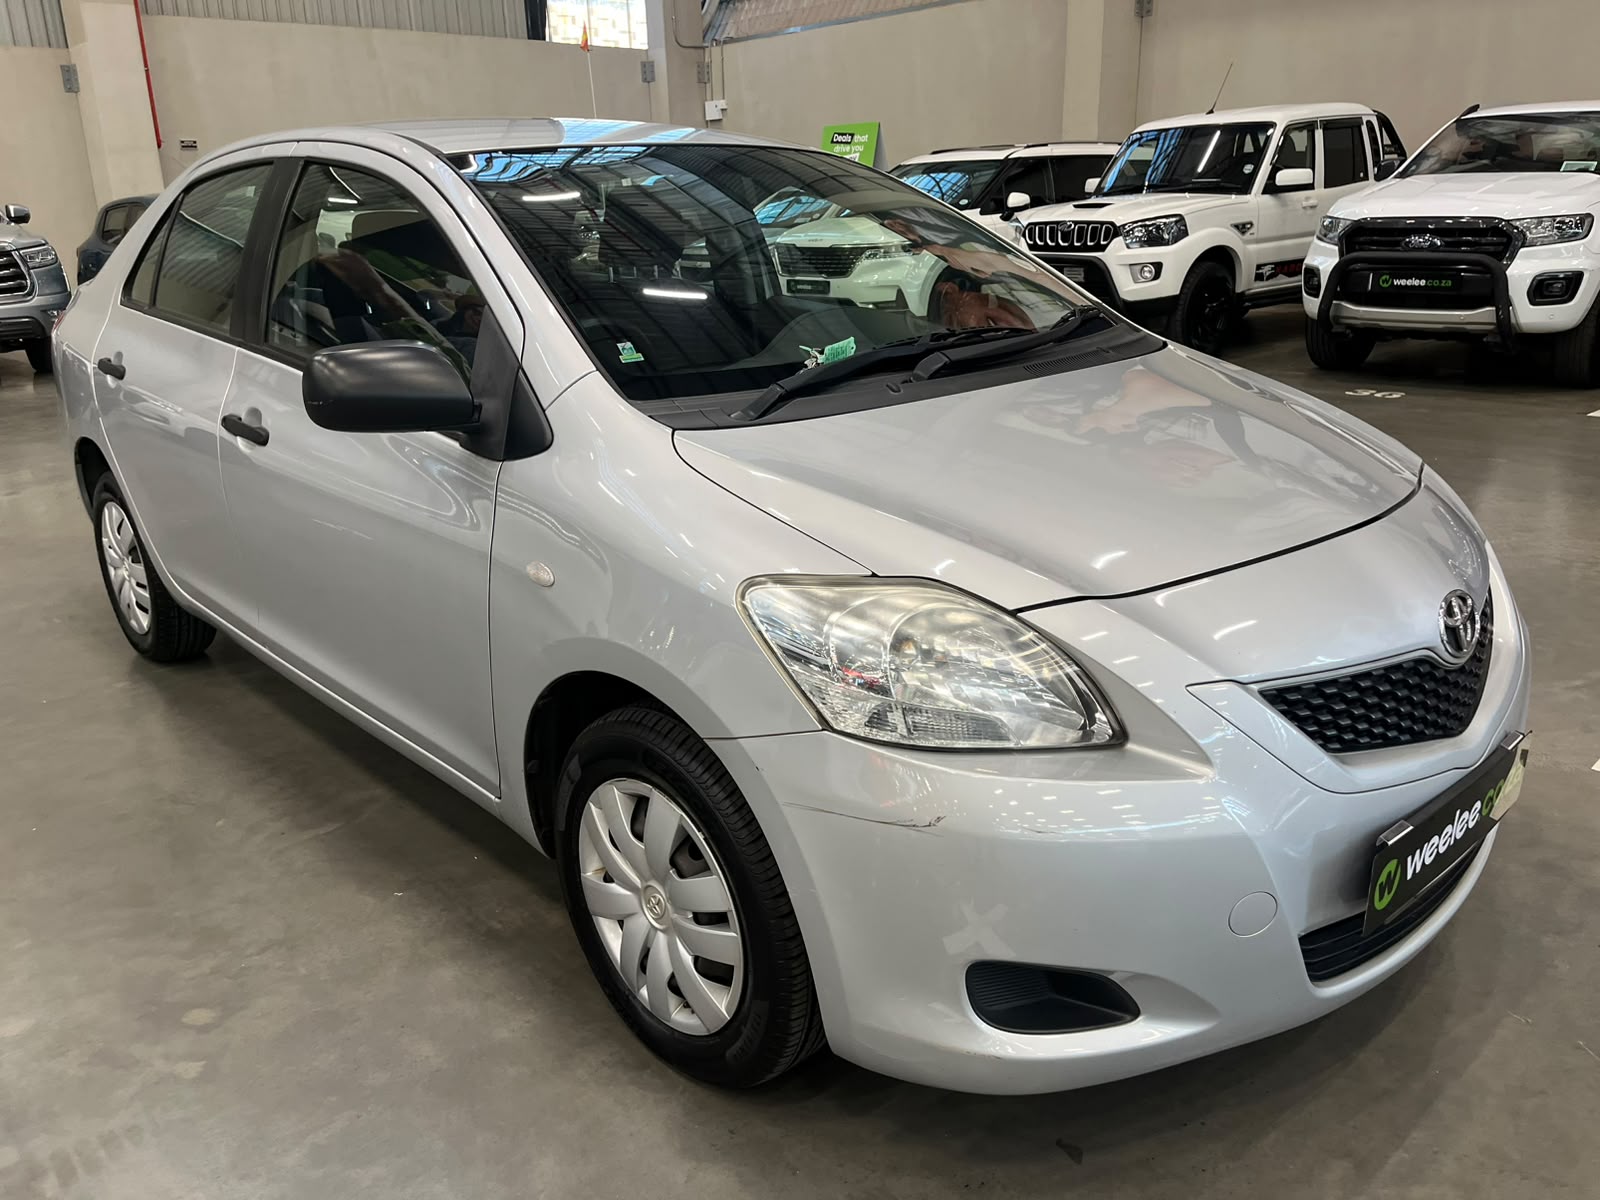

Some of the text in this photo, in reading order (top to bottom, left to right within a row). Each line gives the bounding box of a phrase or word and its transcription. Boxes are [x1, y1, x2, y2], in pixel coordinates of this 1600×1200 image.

[833, 134, 868, 142] Deals that
[833, 145, 864, 154] drive you
